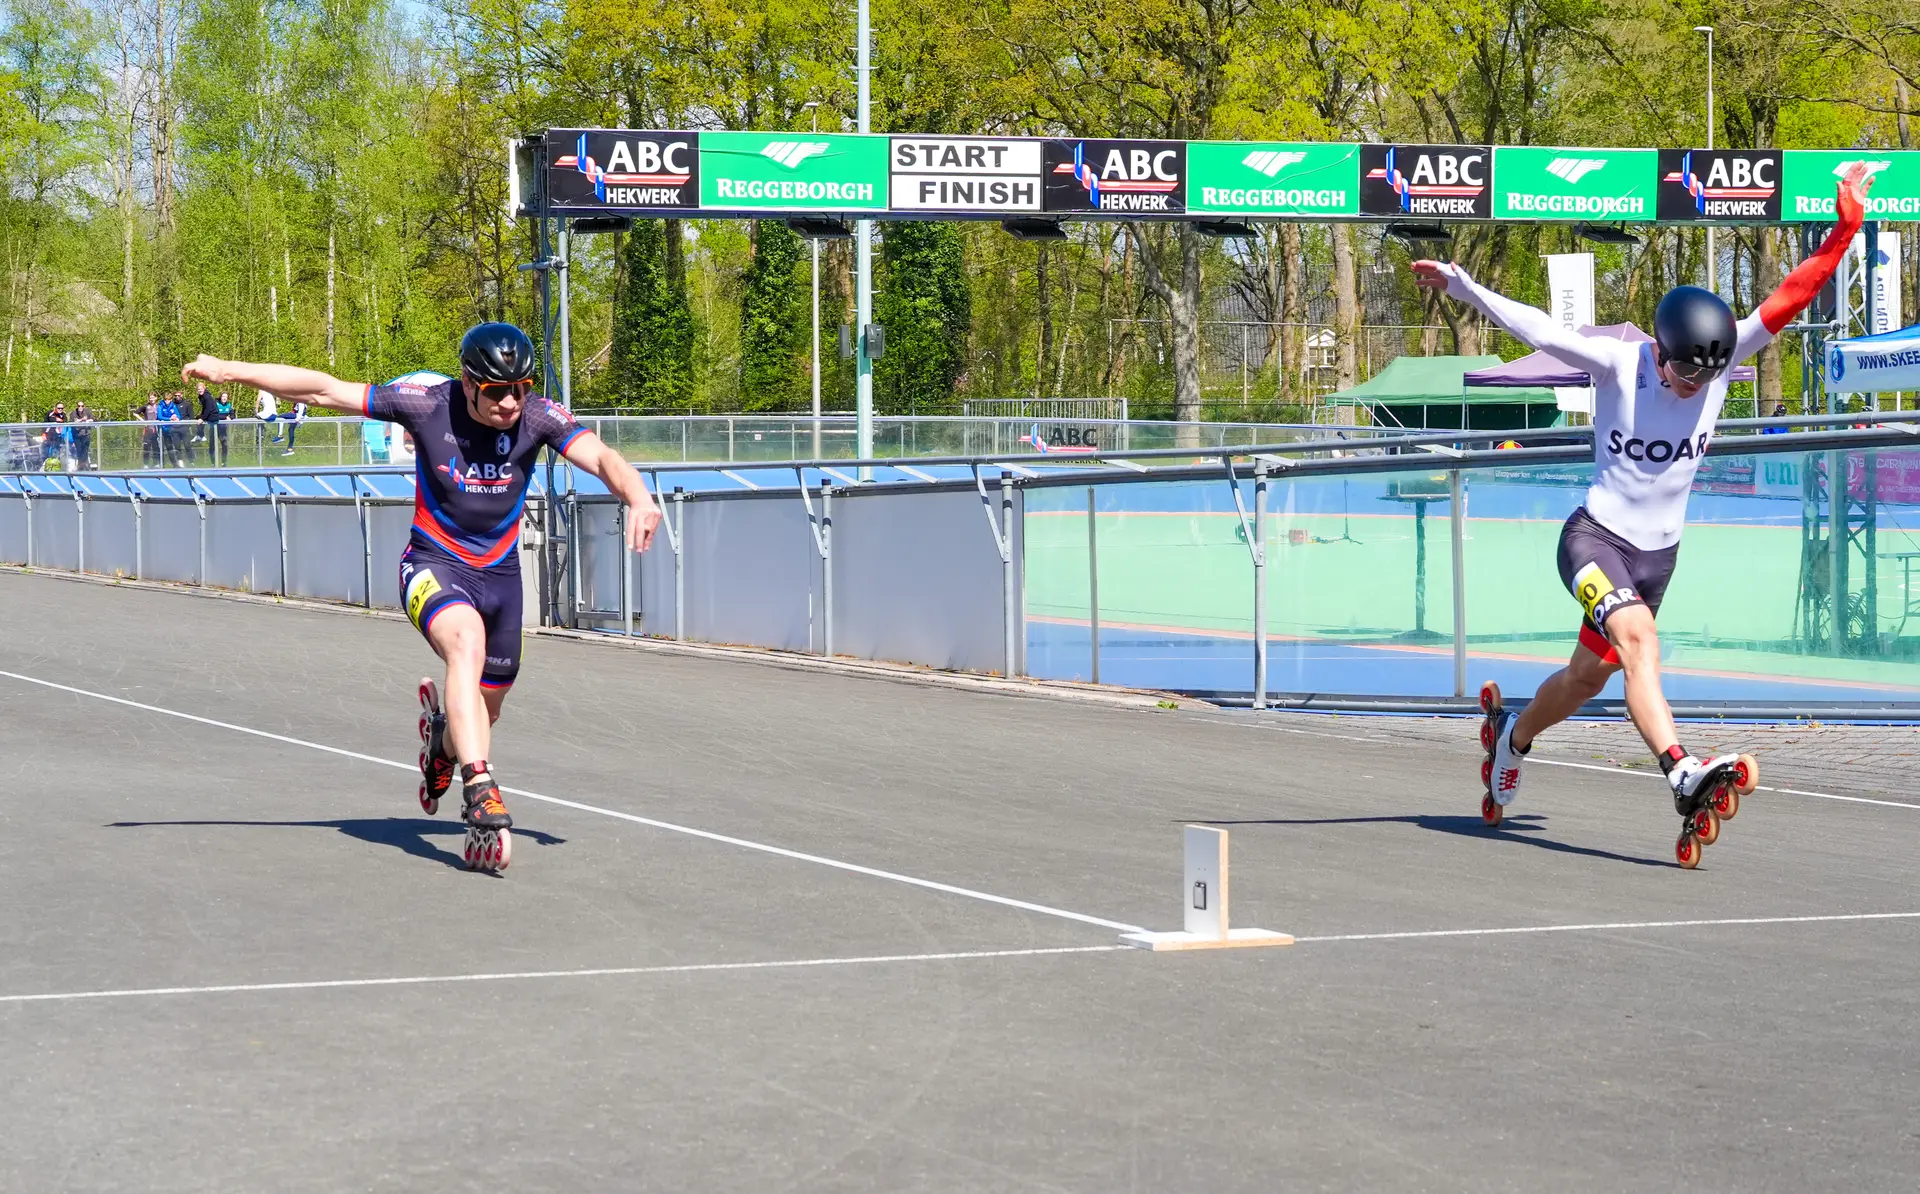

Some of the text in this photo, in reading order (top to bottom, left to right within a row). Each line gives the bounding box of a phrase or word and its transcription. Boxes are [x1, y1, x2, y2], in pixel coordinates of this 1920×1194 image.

[607, 141, 690, 174] ABC
[896, 144, 1009, 168] START
[1101, 149, 1178, 181] ABC
[1411, 154, 1484, 186] ABC
[1706, 158, 1775, 187] ABC
[606, 187, 681, 205] HEKWERK
[716, 178, 873, 201] REGGEBORGH
[919, 181, 1034, 205] FINISH
[1202, 187, 1346, 208] REGGEBORGH
[1100, 194, 1169, 210] HEKWERK
[1410, 198, 1476, 215] HEKWERK
[1506, 192, 1644, 214] REGGEBORGH
[1704, 201, 1767, 216] HEKWERK
[1050, 427, 1097, 446] ABC
[465, 462, 513, 479] ABC
[465, 484, 509, 494] HEKWERK
